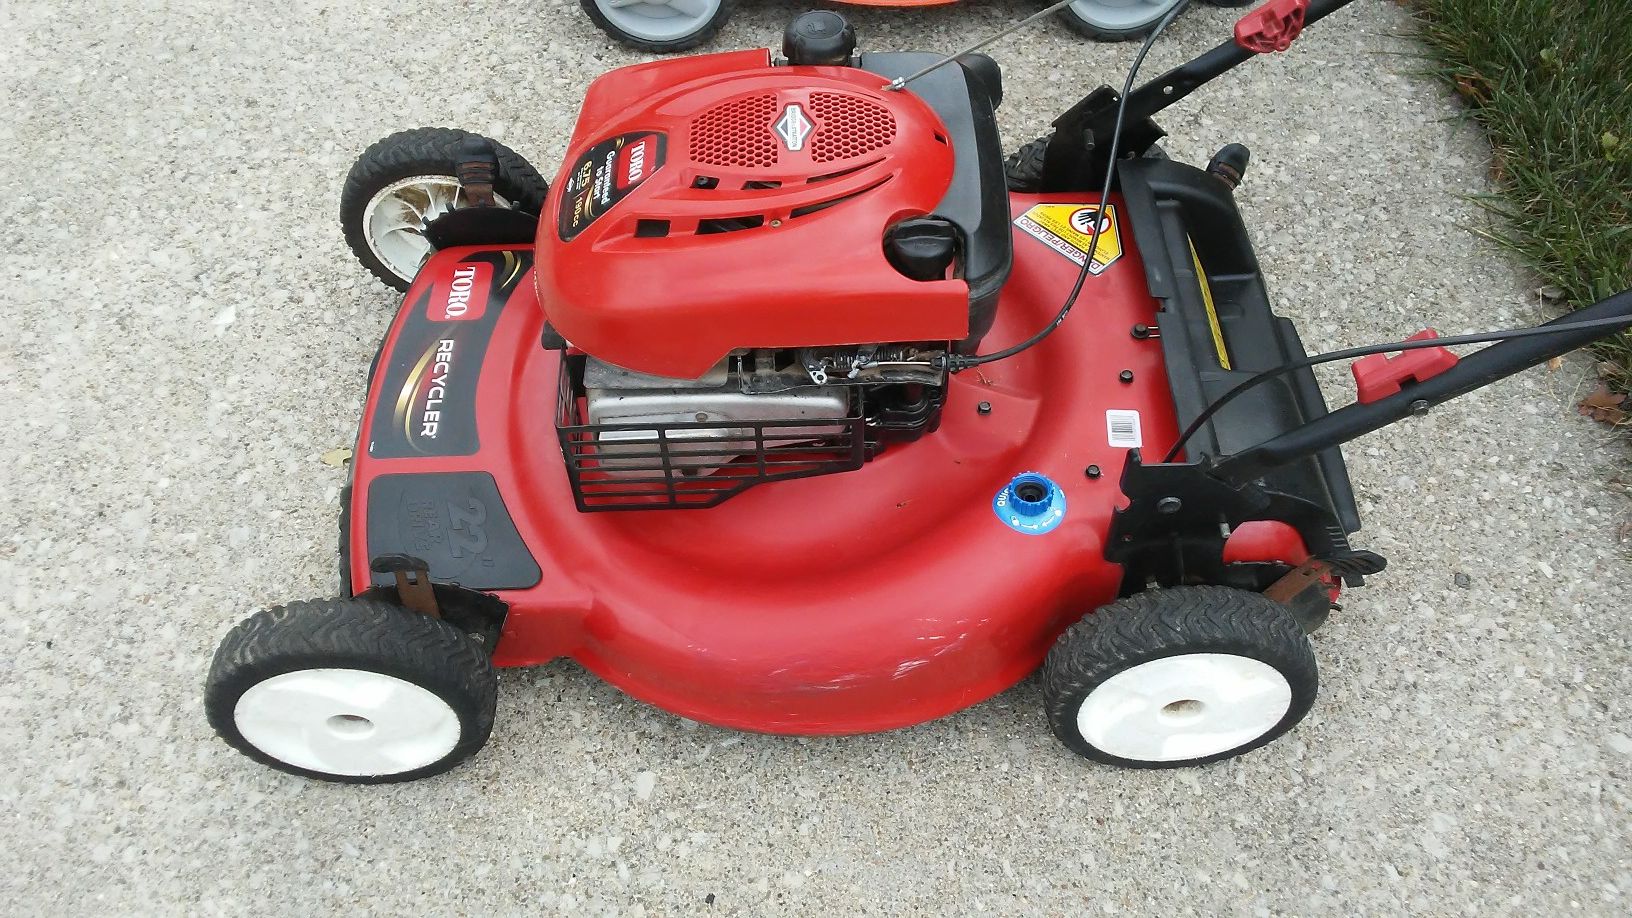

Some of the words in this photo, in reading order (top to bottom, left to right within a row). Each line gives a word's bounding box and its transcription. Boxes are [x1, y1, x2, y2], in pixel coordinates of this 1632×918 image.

[595, 166, 605, 177] to
[601, 150, 616, 205] Guaranteed
[628, 141, 646, 183] TORO
[593, 176, 604, 200] Start
[572, 197, 583, 228] 190cc
[1020, 218, 1100, 270] DNGER/PELIGRO
[446, 266, 476, 317] TORO
[420, 339, 454, 437] RECYCLER
